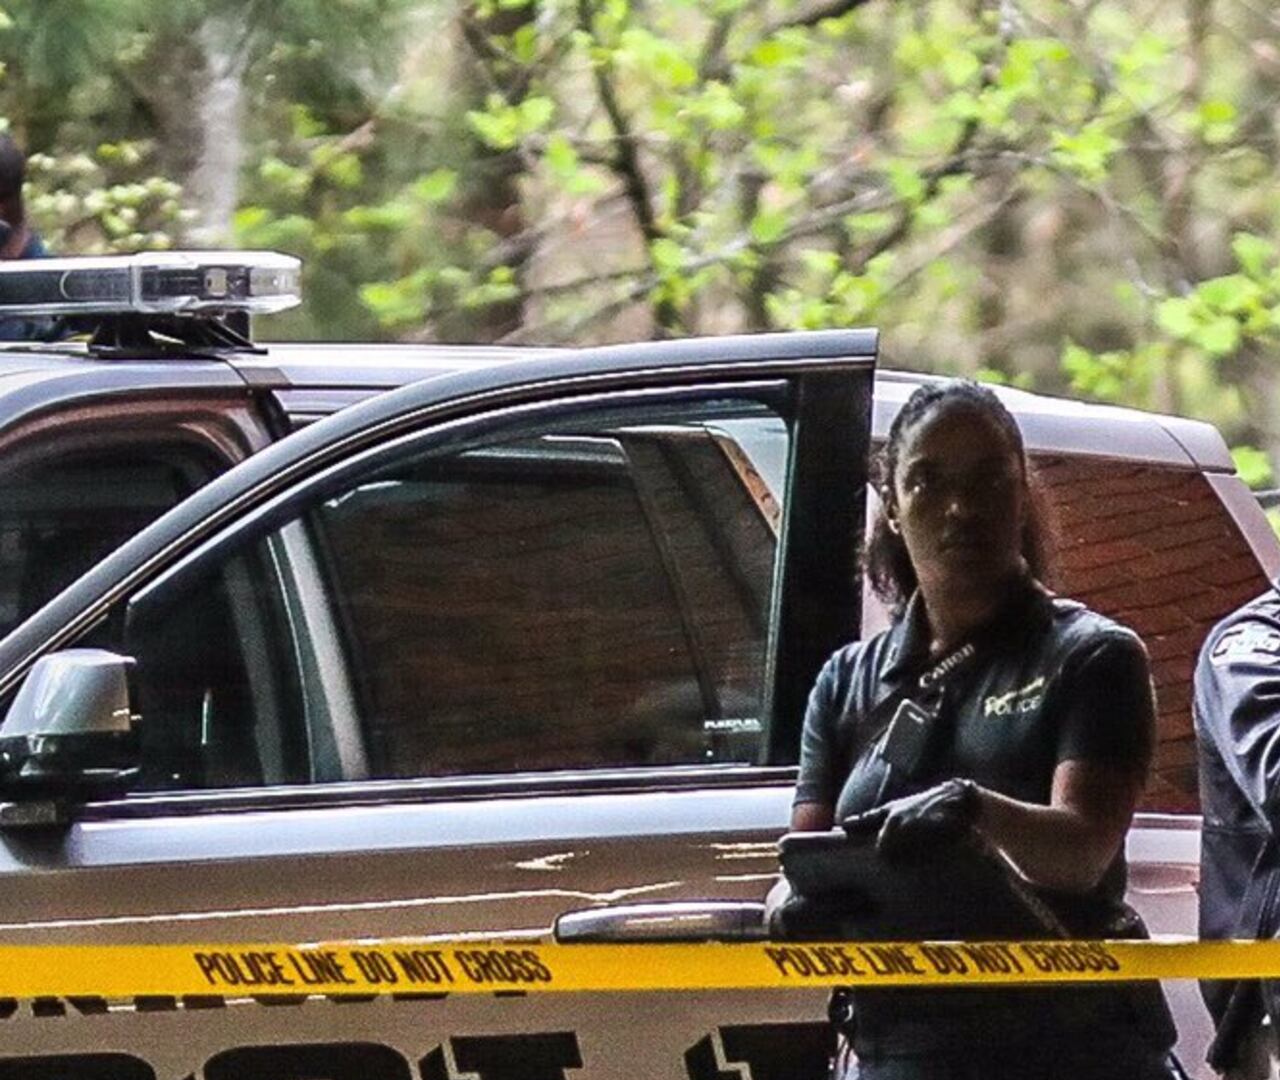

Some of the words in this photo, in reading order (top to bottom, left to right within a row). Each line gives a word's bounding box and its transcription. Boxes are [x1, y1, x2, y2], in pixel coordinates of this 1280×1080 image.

[194, 952, 294, 985] POLICE
[292, 952, 353, 984] LINE
[351, 951, 399, 984] DO
[399, 951, 455, 984] NOT
[454, 950, 552, 983] CROSS
[765, 946, 865, 976] POLICE
[859, 945, 926, 975] LINE
[922, 945, 969, 975] DO
[965, 944, 1025, 974] NOT
[1023, 943, 1119, 973] CROSS
